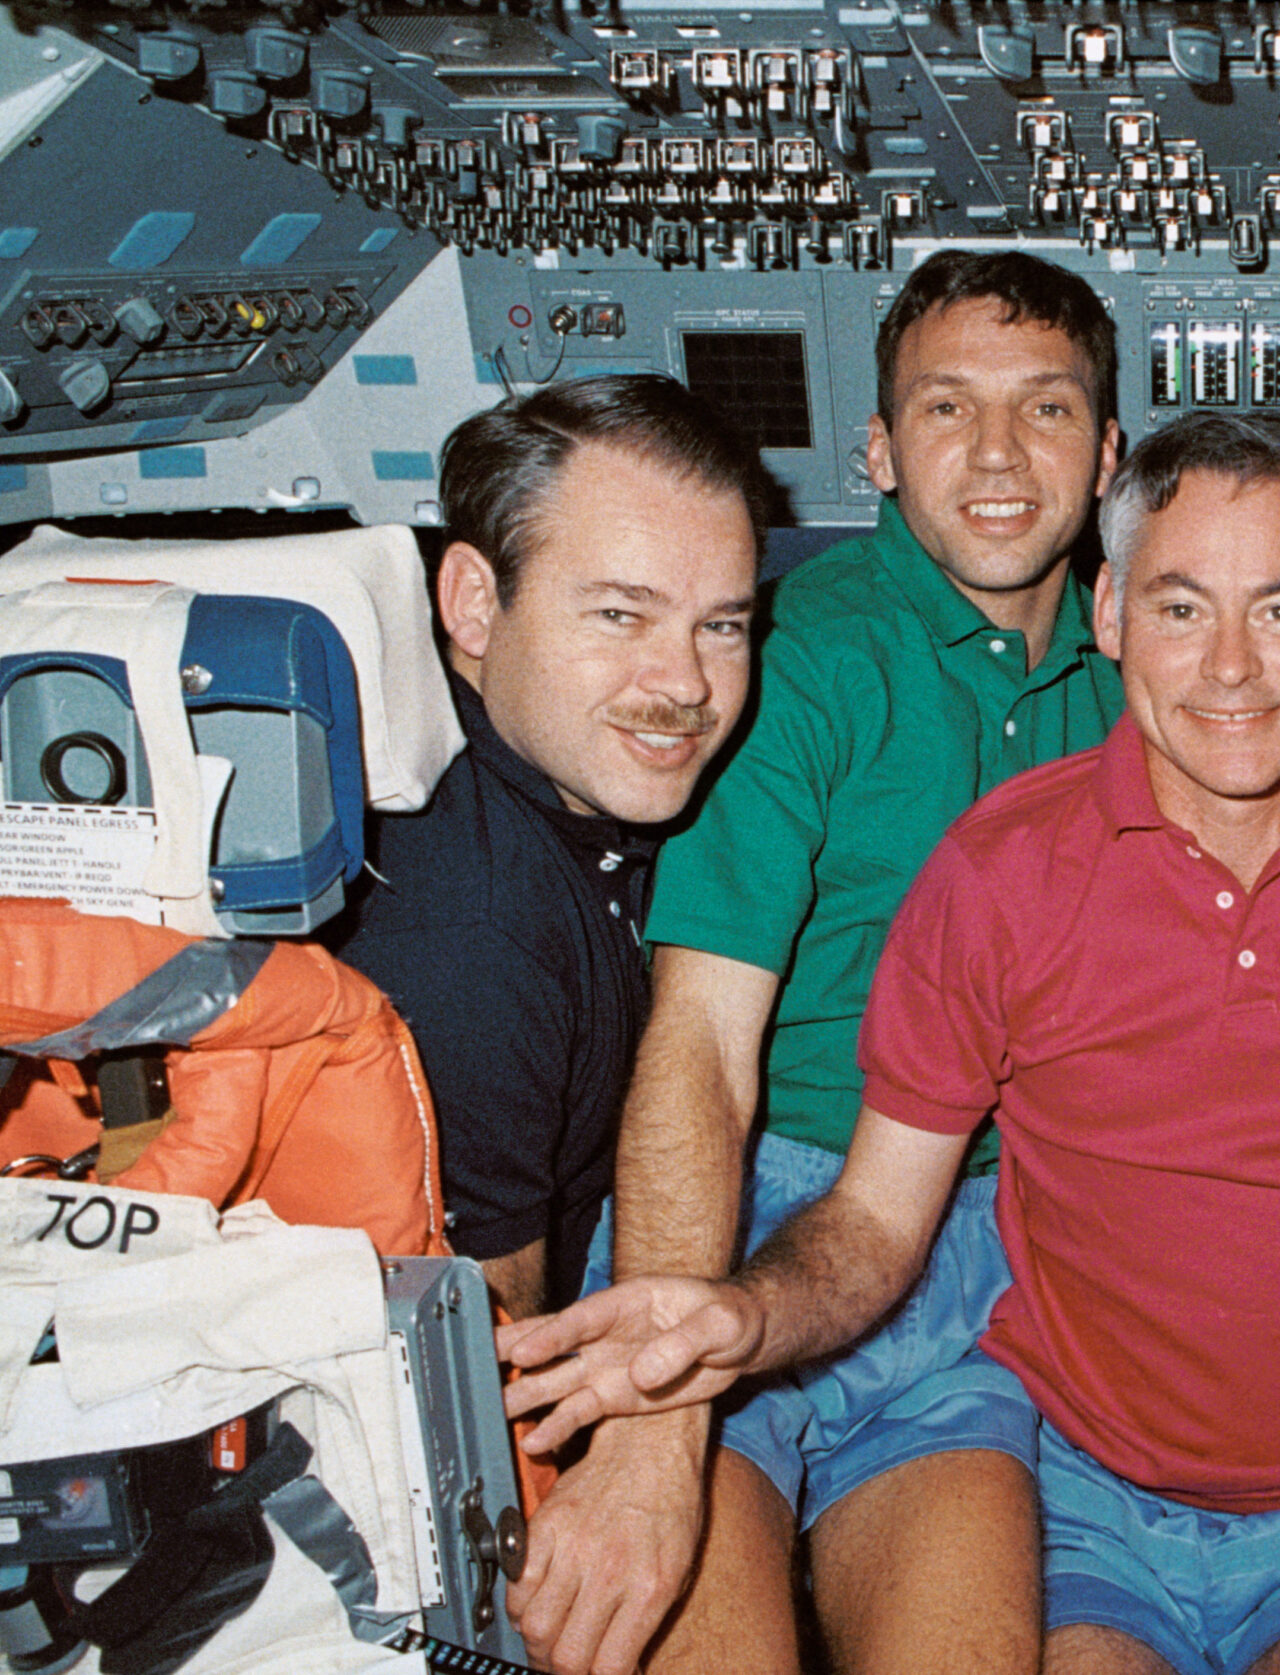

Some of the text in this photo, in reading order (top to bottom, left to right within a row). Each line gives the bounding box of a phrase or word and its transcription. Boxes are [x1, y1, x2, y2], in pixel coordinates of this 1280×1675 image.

[48, 815, 88, 827] PANEL
[92, 818, 139, 830] EGRESS
[20, 832, 66, 842] WINDOW
[56, 846, 84, 856] APPLE
[15, 856, 47, 867] PANEL
[17, 882, 76, 892] EMERGENCY
[79, 884, 114, 894] POWER
[37, 1194, 160, 1254] TOP
